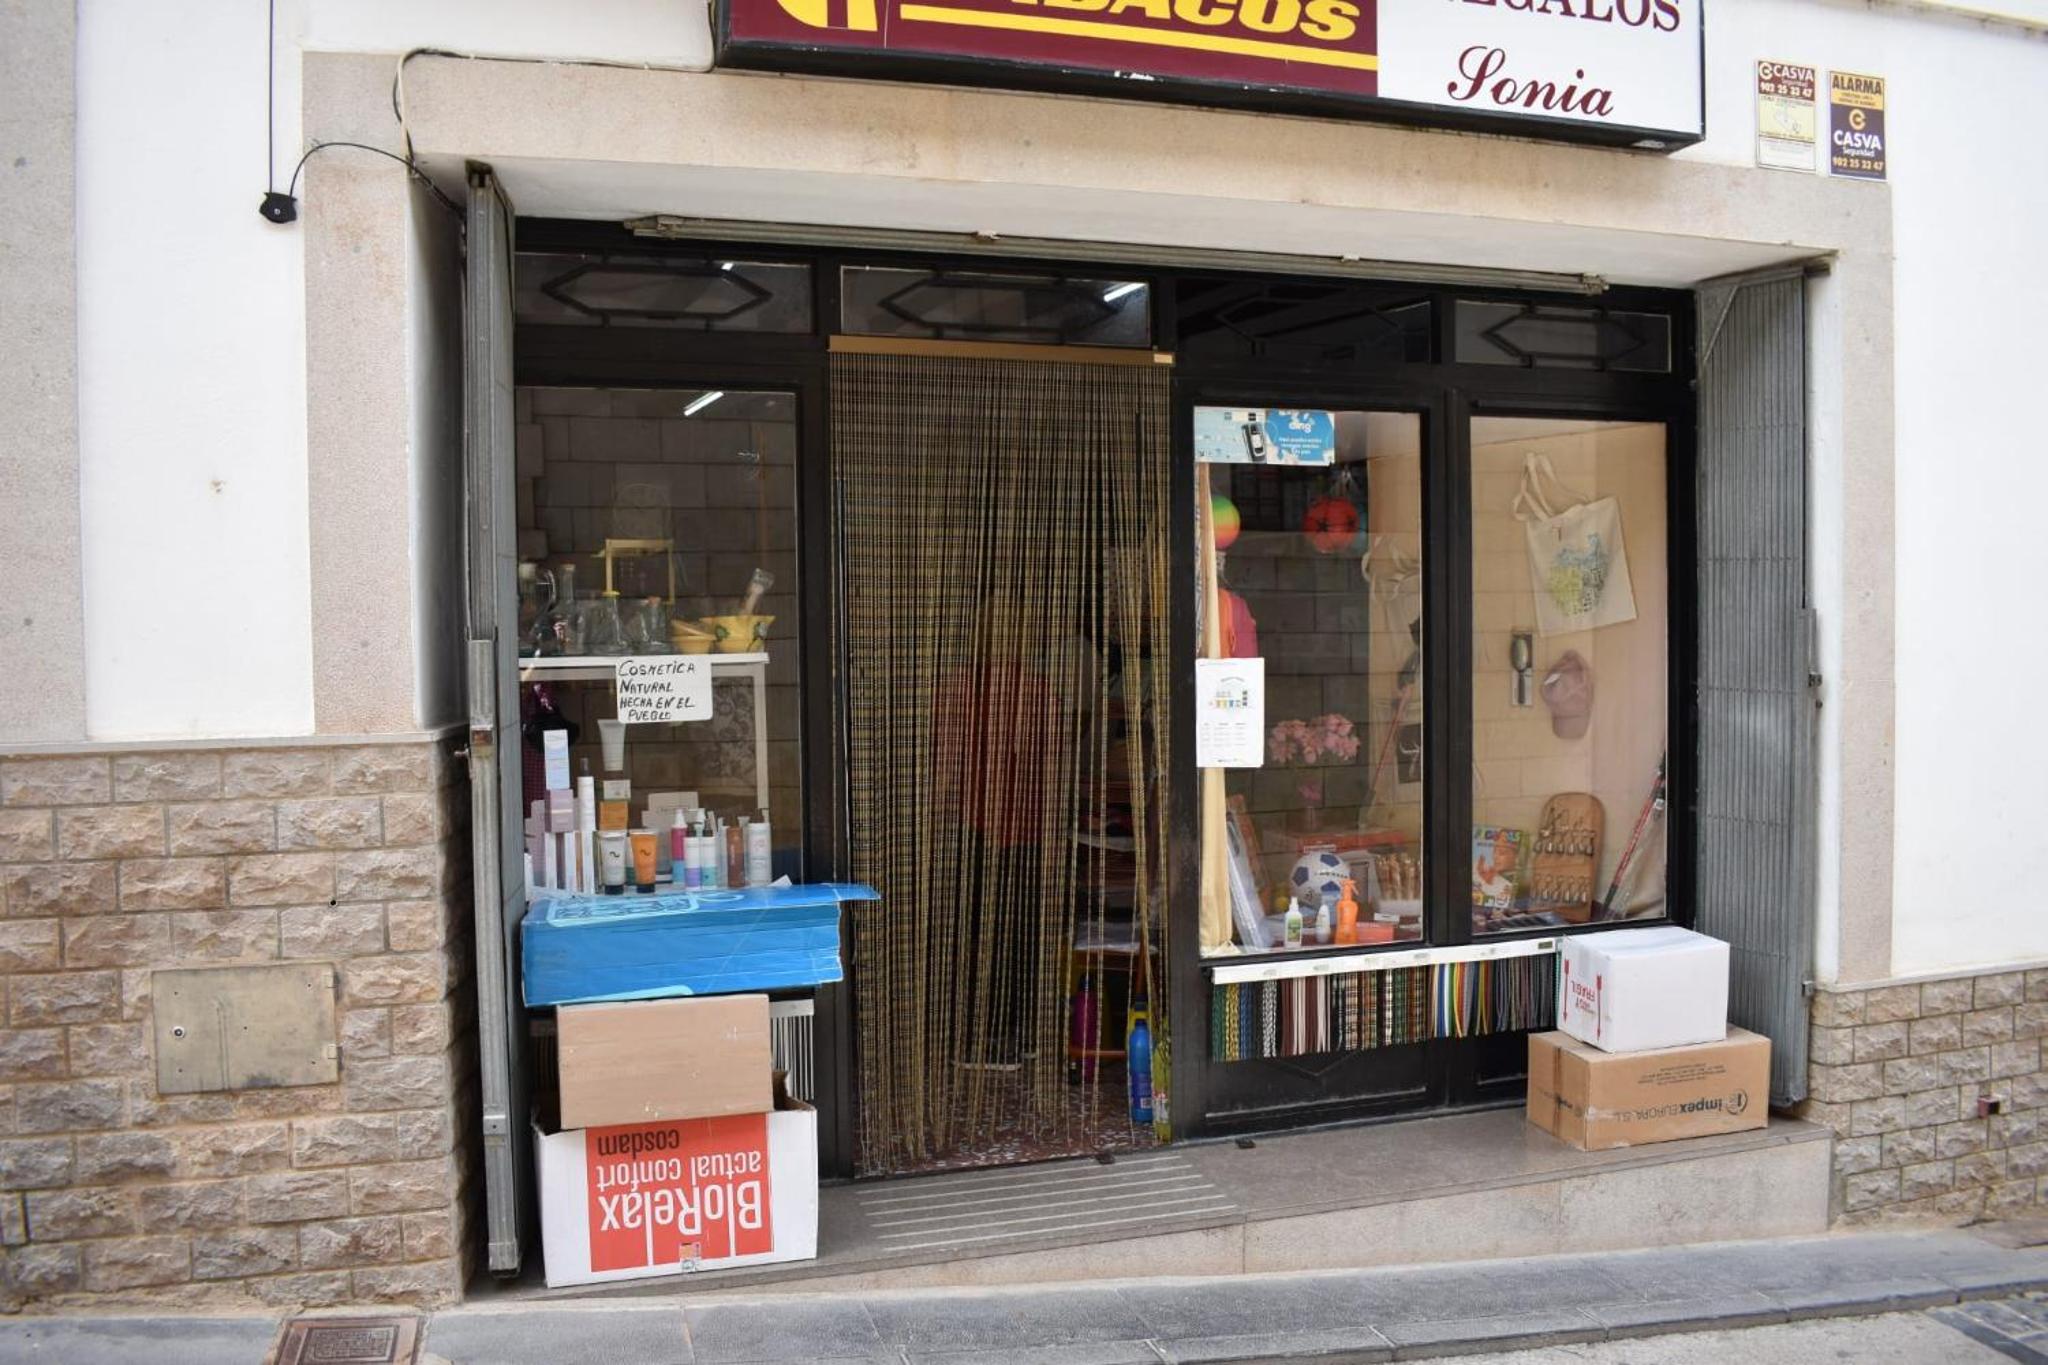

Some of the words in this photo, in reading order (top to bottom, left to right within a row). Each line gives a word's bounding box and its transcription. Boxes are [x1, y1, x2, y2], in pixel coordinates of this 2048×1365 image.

[1447, 46, 1614, 116] Sonia
[1773, 65, 1814, 82] CASVA
[1832, 74, 1882, 95] ALARMA
[1833, 130, 1883, 151] CASVA
[620, 678, 673, 694] NATURAL
[620, 697, 653, 709] HECHA
[656, 697, 675, 709] EN
[677, 696, 696, 709] EL
[628, 709, 672, 721] PUEBLO
[1679, 1097, 1722, 1113] impex
[597, 1129, 680, 1160] cosdam
[596, 1158, 681, 1193] confort
[691, 1150, 761, 1187] actual
